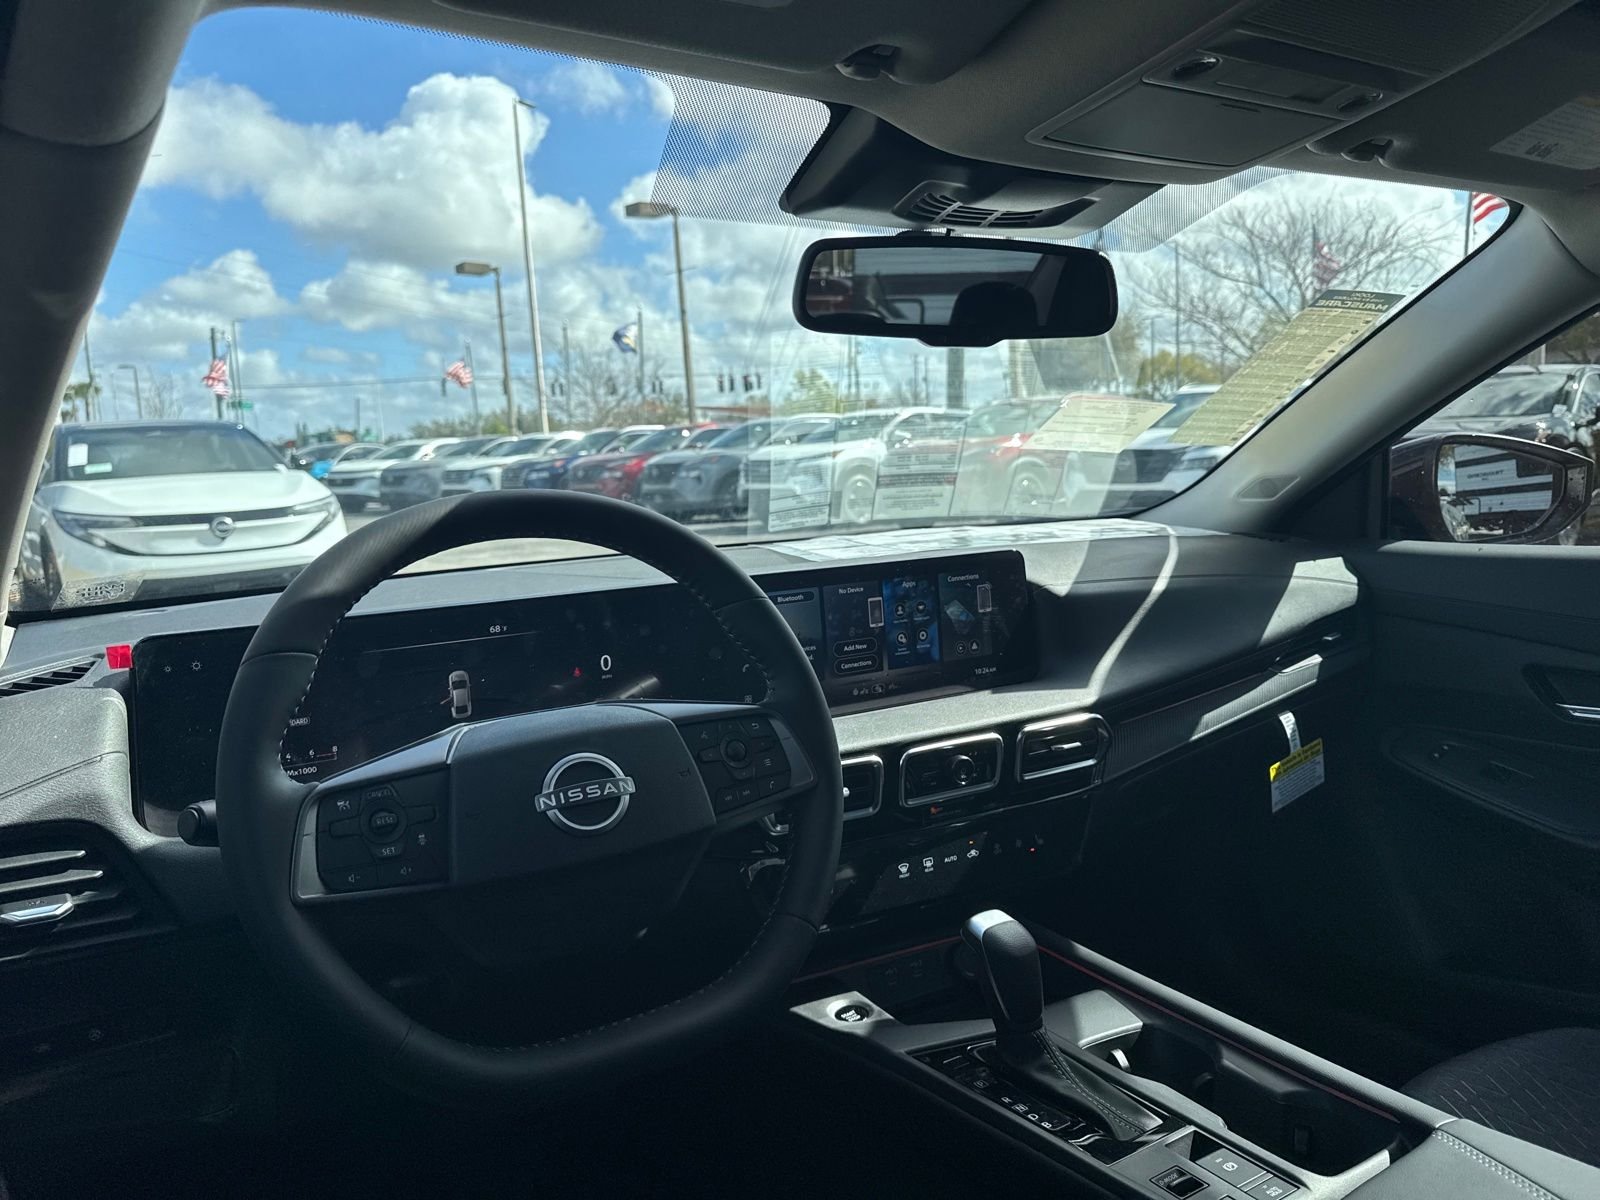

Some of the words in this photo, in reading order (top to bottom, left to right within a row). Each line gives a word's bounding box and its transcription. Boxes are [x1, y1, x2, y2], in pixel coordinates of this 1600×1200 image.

[947, 574, 979, 582] Connections
[777, 594, 804, 602] Bluetooth
[600, 654, 612, 671] 0
[841, 660, 872, 669] Connections
[539, 781, 633, 809] NISSAN
[1027, 1113, 1039, 1121] D
